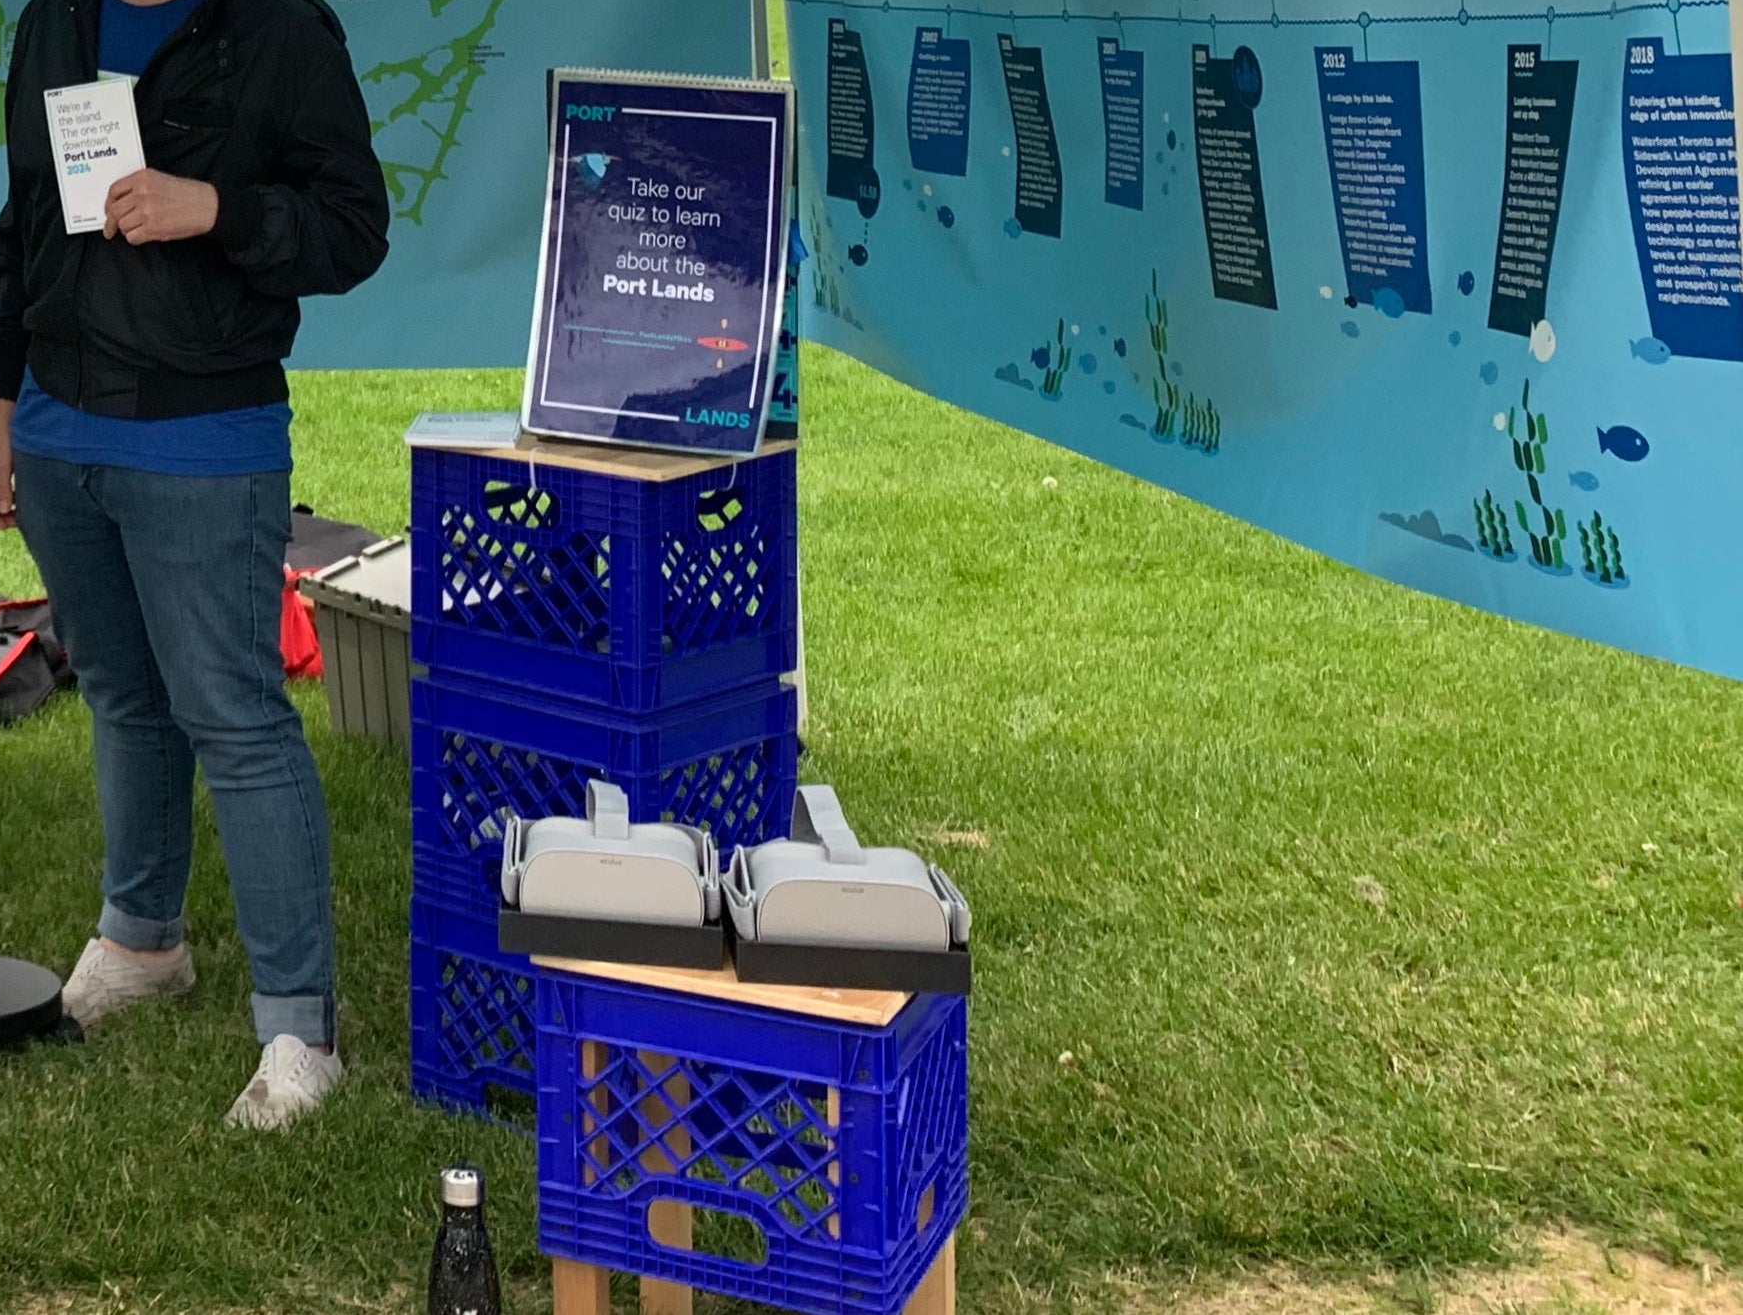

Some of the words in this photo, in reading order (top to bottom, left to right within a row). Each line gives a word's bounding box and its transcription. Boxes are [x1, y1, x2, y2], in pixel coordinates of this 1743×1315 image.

[1323, 53, 1346, 69] 2012
[1514, 52, 1535, 68] 2015
[1630, 46, 1655, 63] 2018
[47, 90, 62, 98] PORT
[82, 100, 91, 110] at
[1629, 95, 1666, 109] Exploring
[1667, 96, 1683, 107] the
[1684, 95, 1721, 109] leading
[566, 104, 616, 122] PORT
[1630, 111, 1649, 123] edge
[1650, 110, 1659, 121] of
[1661, 111, 1688, 121] urban
[1689, 109, 1735, 121] innovatio
[58, 116, 73, 126] the
[61, 128, 78, 139] The
[80, 126, 97, 136] one
[99, 120, 120, 134] right
[1631, 135, 1677, 147] Waterfront
[1678, 135, 1714, 147] Toronto
[1715, 136, 1733, 147] and
[64, 150, 85, 162] Port
[87, 146, 117, 159] Lands
[1674, 150, 1697, 162] Labs
[67, 164, 91, 175] 2024
[1635, 164, 1693, 177] Development
[627, 177, 669, 198] Take
[674, 184, 706, 201] our
[1689, 194, 1699, 205] to
[608, 203, 645, 223] quiz
[652, 205, 670, 224] to
[676, 206, 721, 228] learn
[1642, 207, 1660, 218] how
[1676, 222, 1693, 233] and
[638, 232, 687, 250] more
[1677, 250, 1686, 261] of
[615, 252, 669, 272] about
[674, 256, 706, 276] the
[603, 274, 647, 296] Port
[651, 279, 715, 302] Lands
[1656, 278, 1673, 288] and
[684, 407, 751, 429] LANDS
